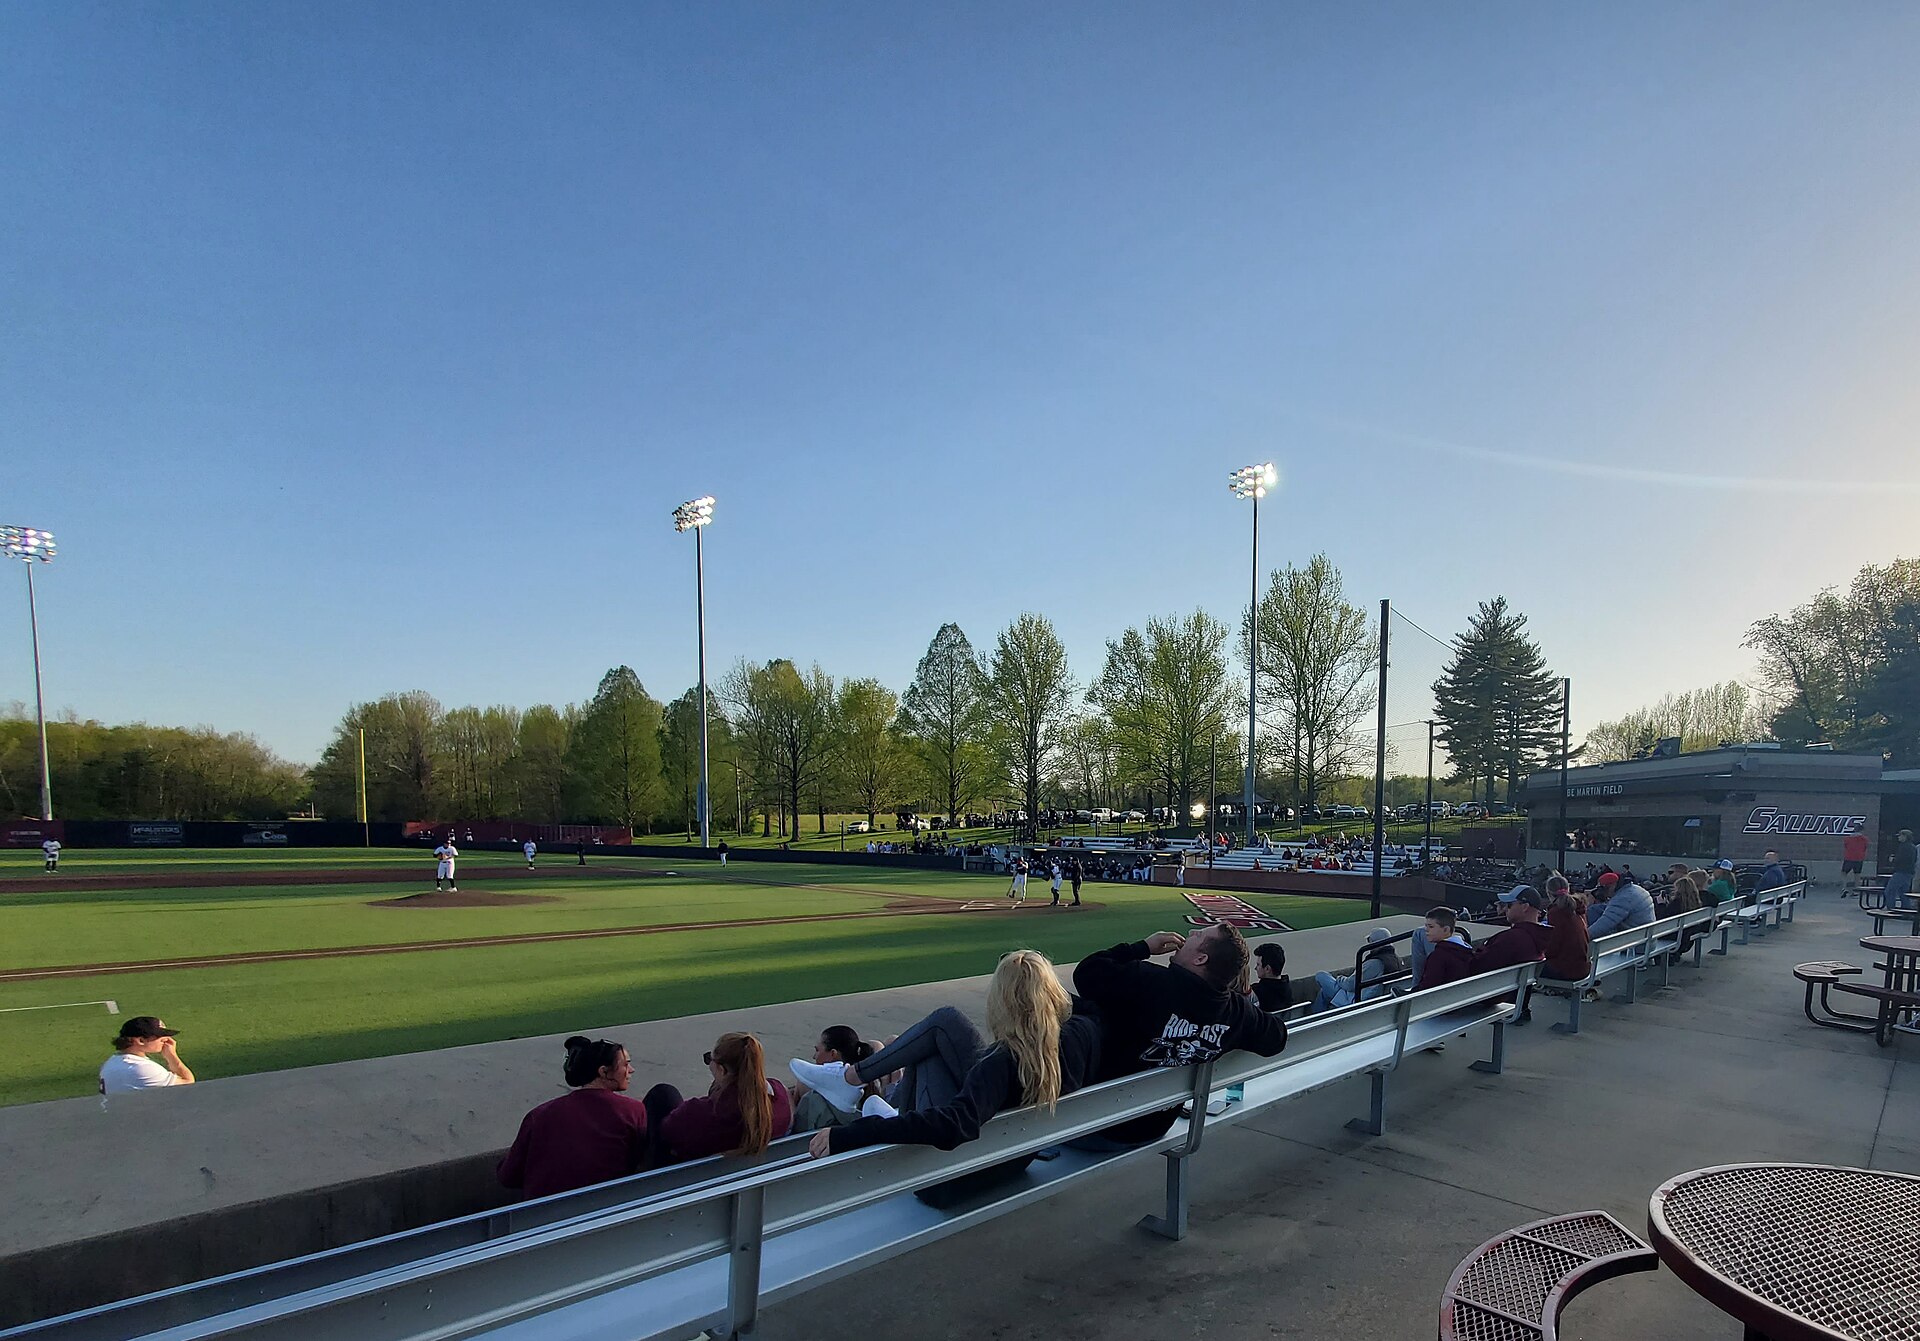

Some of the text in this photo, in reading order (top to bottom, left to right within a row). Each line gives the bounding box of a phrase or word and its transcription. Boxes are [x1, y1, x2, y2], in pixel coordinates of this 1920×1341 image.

[1576, 786, 1601, 797] MARTIN
[1602, 784, 1623, 795] FIELD
[1743, 806, 1866, 835] SALUKIS
[1162, 1013, 1231, 1047] RIDE AST
